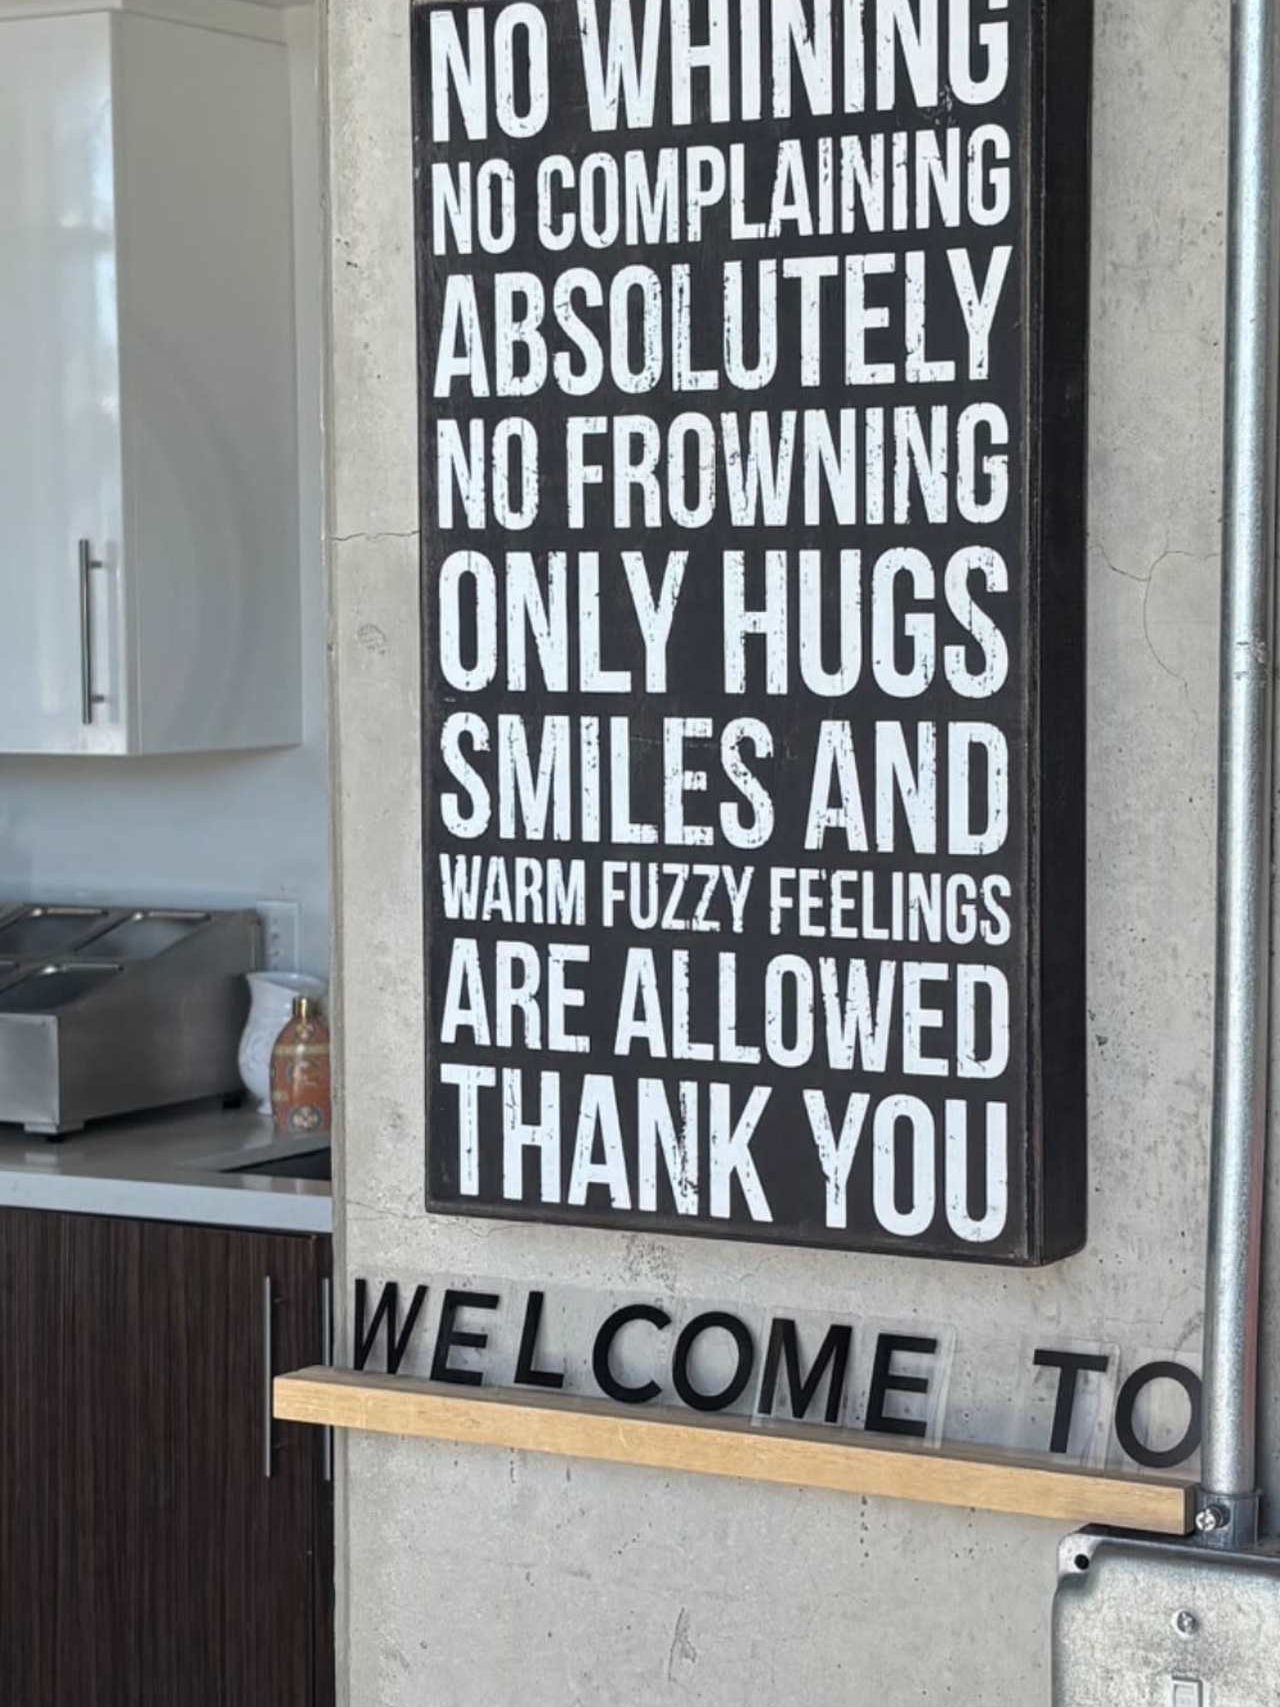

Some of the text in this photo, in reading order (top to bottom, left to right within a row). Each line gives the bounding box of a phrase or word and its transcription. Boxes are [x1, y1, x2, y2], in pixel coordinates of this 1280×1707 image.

[430, 3, 548, 143] NO
[431, 124, 1011, 256] NO COMPLAINING
[433, 245, 1013, 398] ABSOLUTELY
[436, 402, 1009, 530] NO FROWNING
[438, 546, 1009, 699] ONLY HUGS
[439, 712, 1009, 855] SMILES AND
[439, 854, 1011, 945] WARM FUZZY FEELINGS
[440, 938, 1009, 1079] ARE ALLOWED
[440, 1064, 1008, 1243] THANK YOU
[353, 1278, 1205, 1470] WELCOME TO
